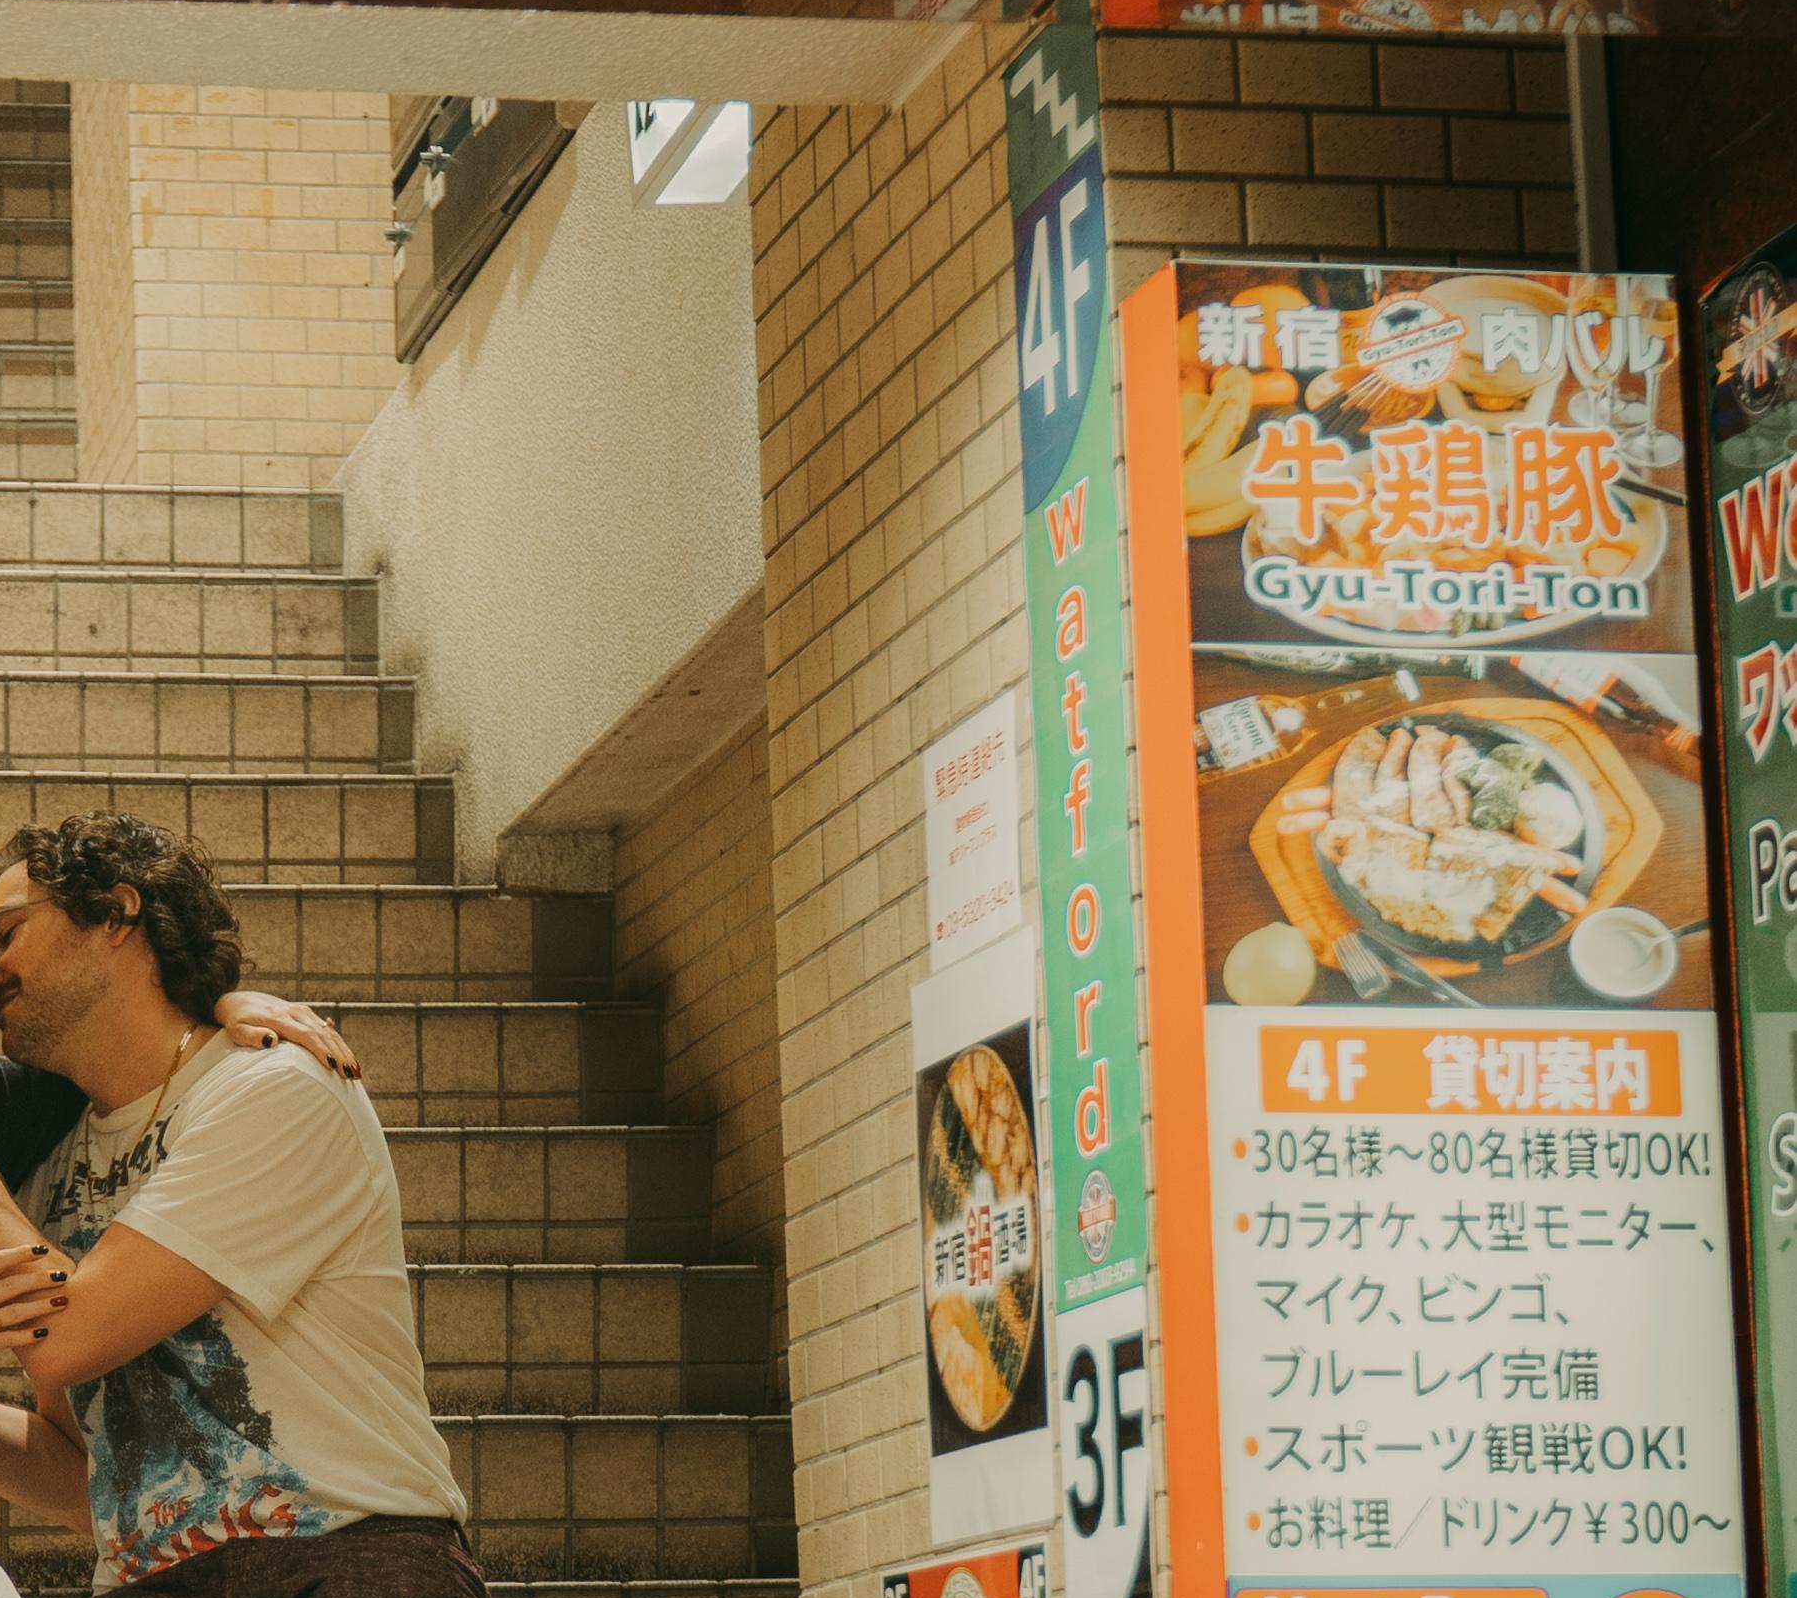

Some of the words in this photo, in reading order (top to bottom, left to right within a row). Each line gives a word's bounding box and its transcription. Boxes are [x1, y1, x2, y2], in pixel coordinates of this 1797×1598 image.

[1019, 176, 1091, 421] 4F
[1197, 302, 1341, 370] 新宿
[1482, 307, 1665, 374] 肉バル
[1245, 415, 1625, 549] 牛鶏豚
[1251, 561, 1644, 611] Gyu-Tori-Ton
[1286, 1038, 1367, 1102] 4F
[1422, 1034, 1650, 1111] 貸切案内
[1262, 1345, 1601, 1401] ブルーレイ完備
[1063, 1329, 1146, 1538] 3F
[1265, 1420, 1688, 1474] スポーツ観戦OK!
